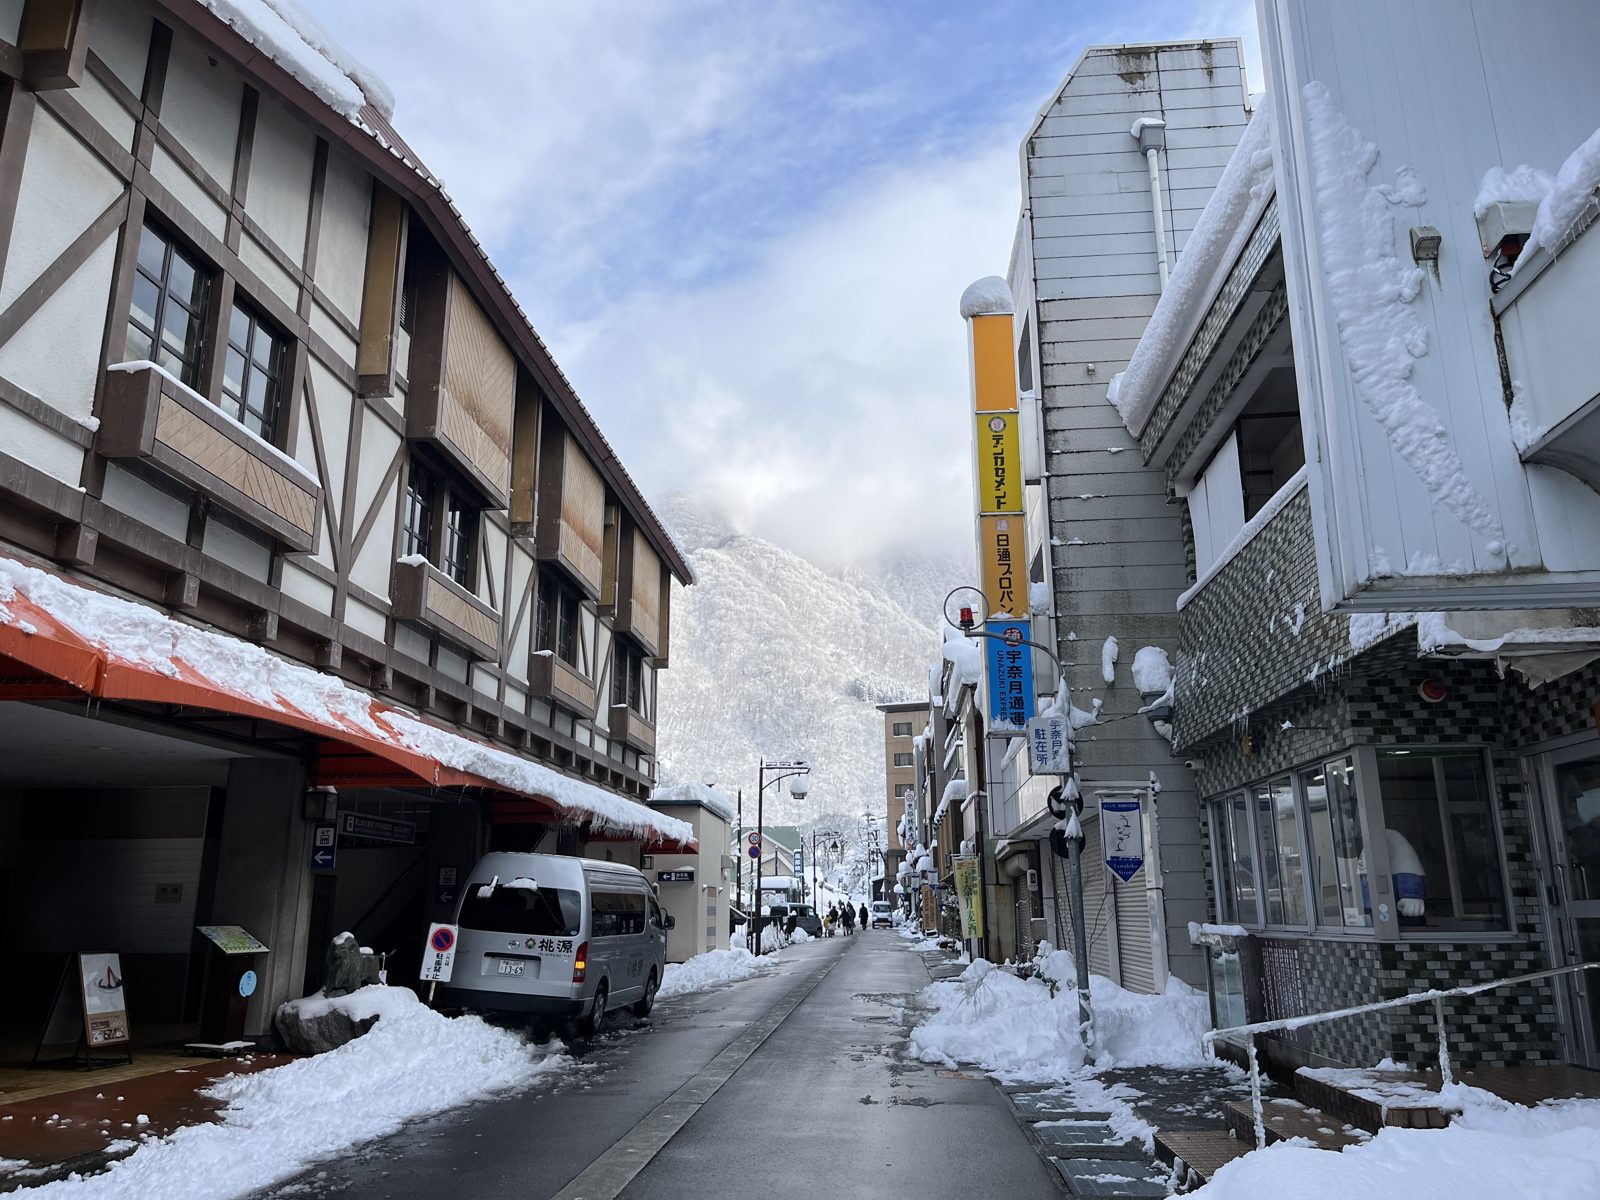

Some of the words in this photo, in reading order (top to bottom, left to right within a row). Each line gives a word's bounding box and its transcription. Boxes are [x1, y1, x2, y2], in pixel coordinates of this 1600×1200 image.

[992, 434, 1007, 509] デンカセメント
[996, 534, 1014, 613] 日通プロパン
[996, 651, 1007, 689] UNAZUKI
[1006, 650, 1026, 727] 宇奈月通運
[1035, 728, 1048, 765] 駐在所
[538, 938, 573, 953] 桃源
